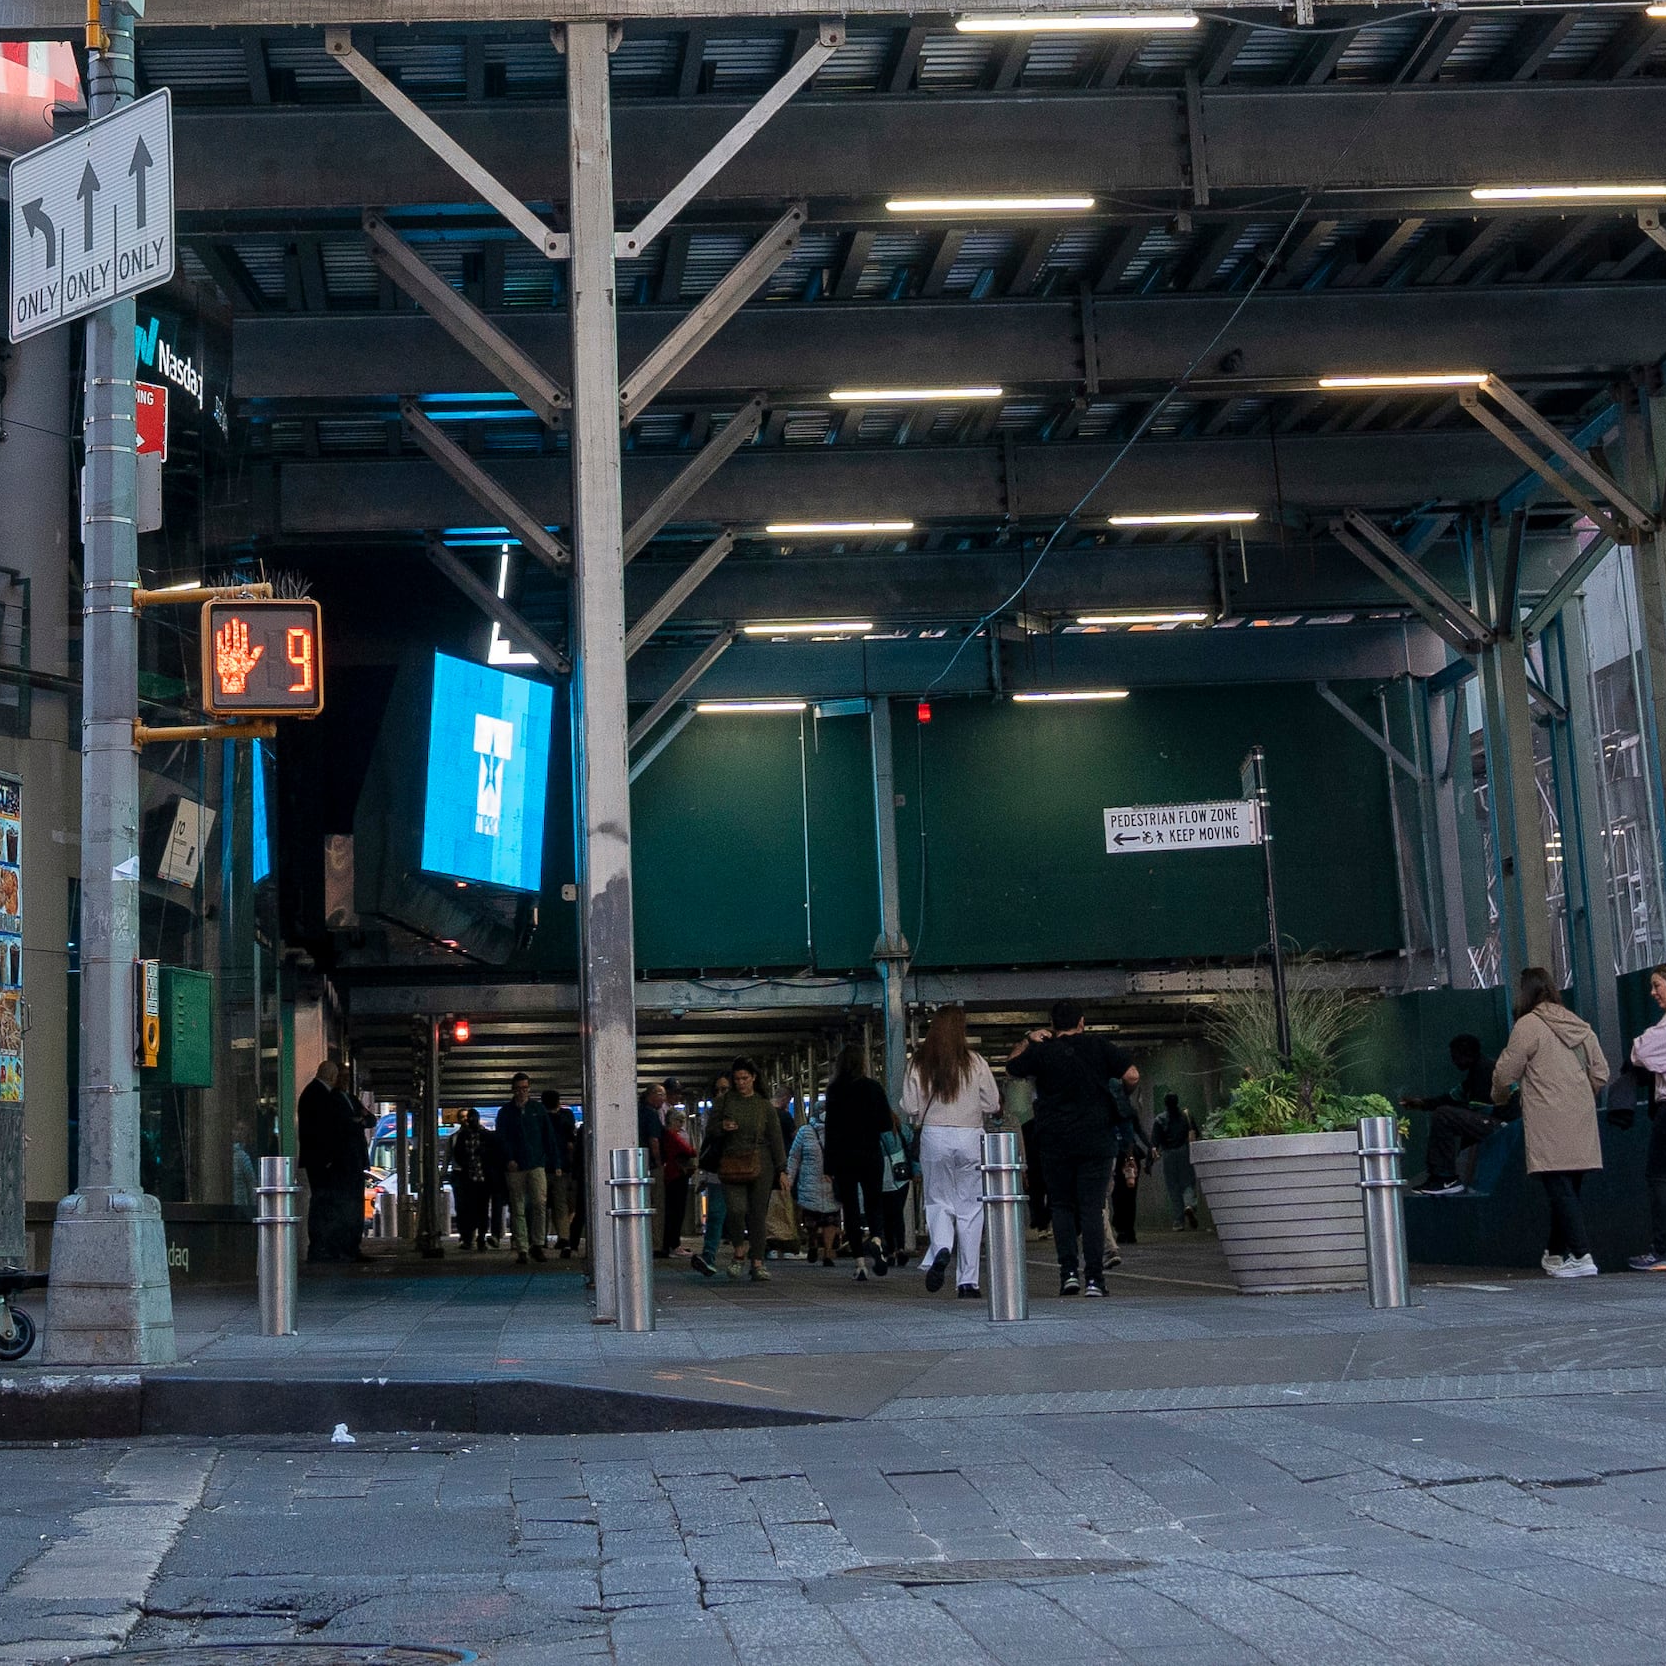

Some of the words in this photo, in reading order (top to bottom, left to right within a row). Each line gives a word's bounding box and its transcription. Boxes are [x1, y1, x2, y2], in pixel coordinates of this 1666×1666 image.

[17, 281, 59, 324] ONLY
[66, 259, 111, 302] ONLY
[119, 236, 165, 280] ONLY
[1111, 811, 1176, 828] PEDESTRIAN
[1179, 809, 1207, 825] FLOW
[1211, 807, 1238, 822] ZONE
[1169, 828, 1195, 843] KEEP
[1199, 825, 1240, 841] MOVING
